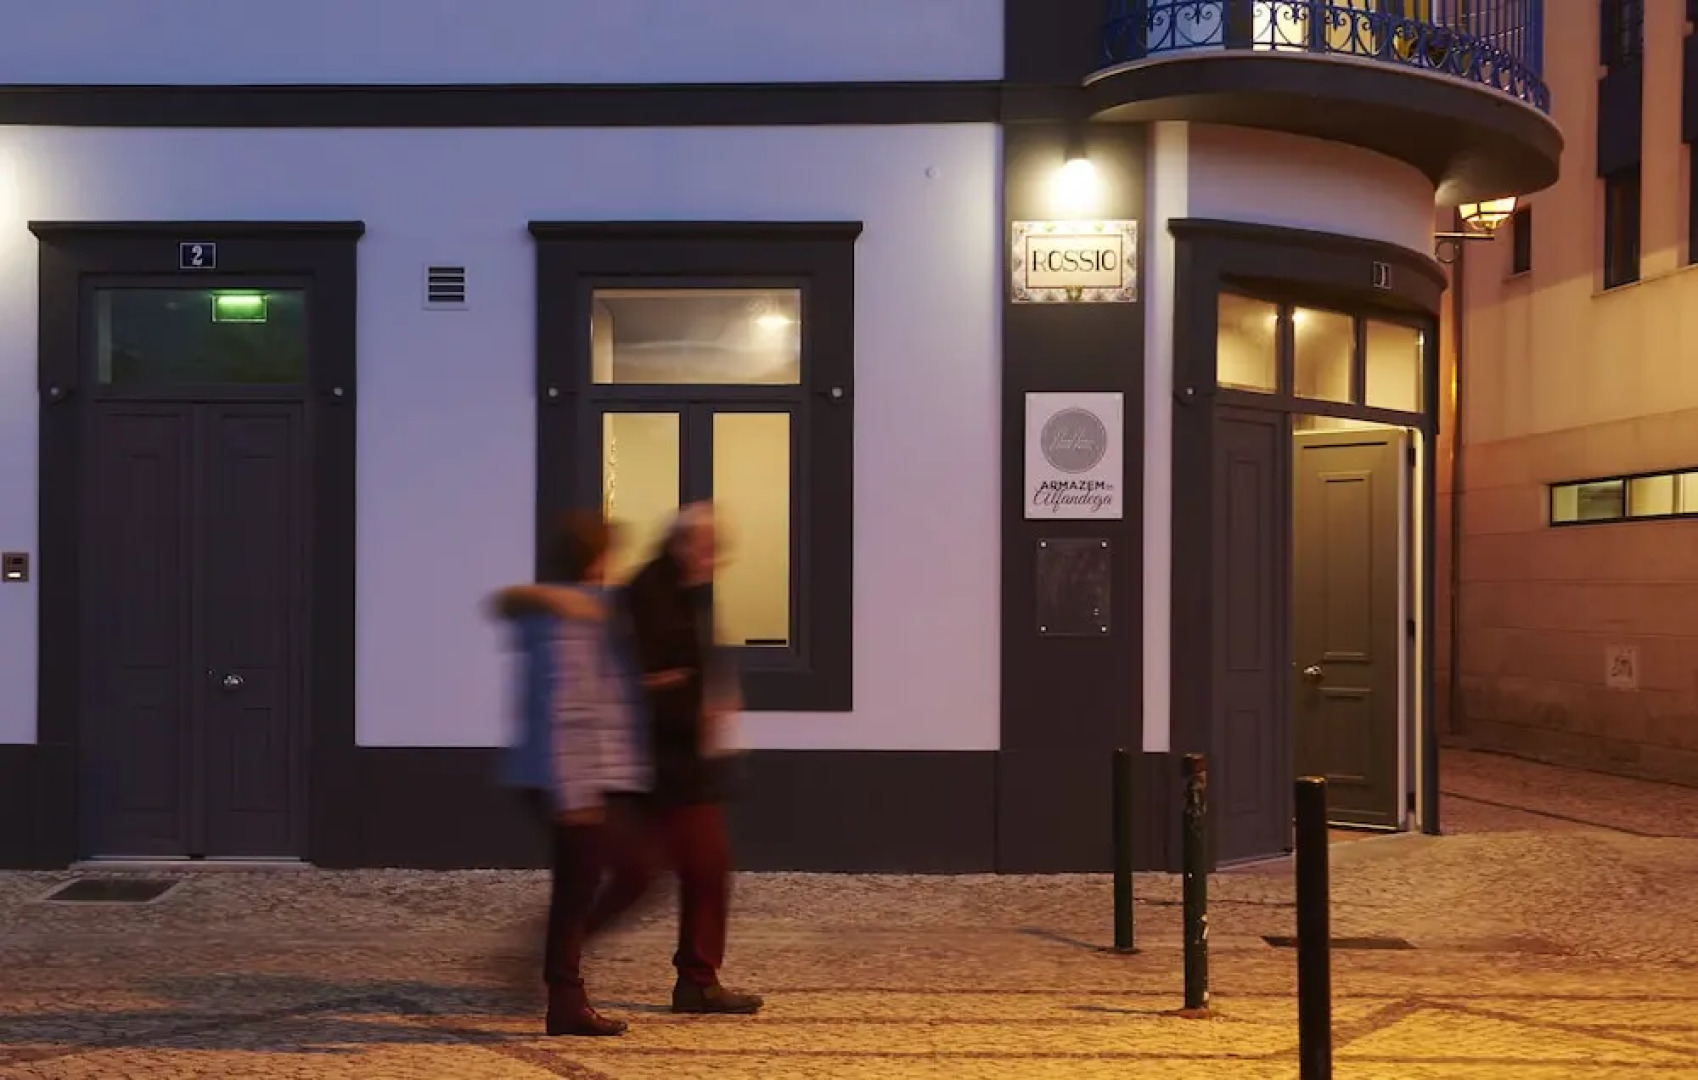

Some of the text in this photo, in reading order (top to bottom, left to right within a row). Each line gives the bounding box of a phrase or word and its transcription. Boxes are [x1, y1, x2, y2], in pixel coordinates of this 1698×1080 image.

[191, 245, 203, 266] 2
[1032, 249, 1117, 272] ROSSIO
[1041, 481, 1105, 490] ARMAZEM
[1033, 485, 1112, 513] Alfandega
